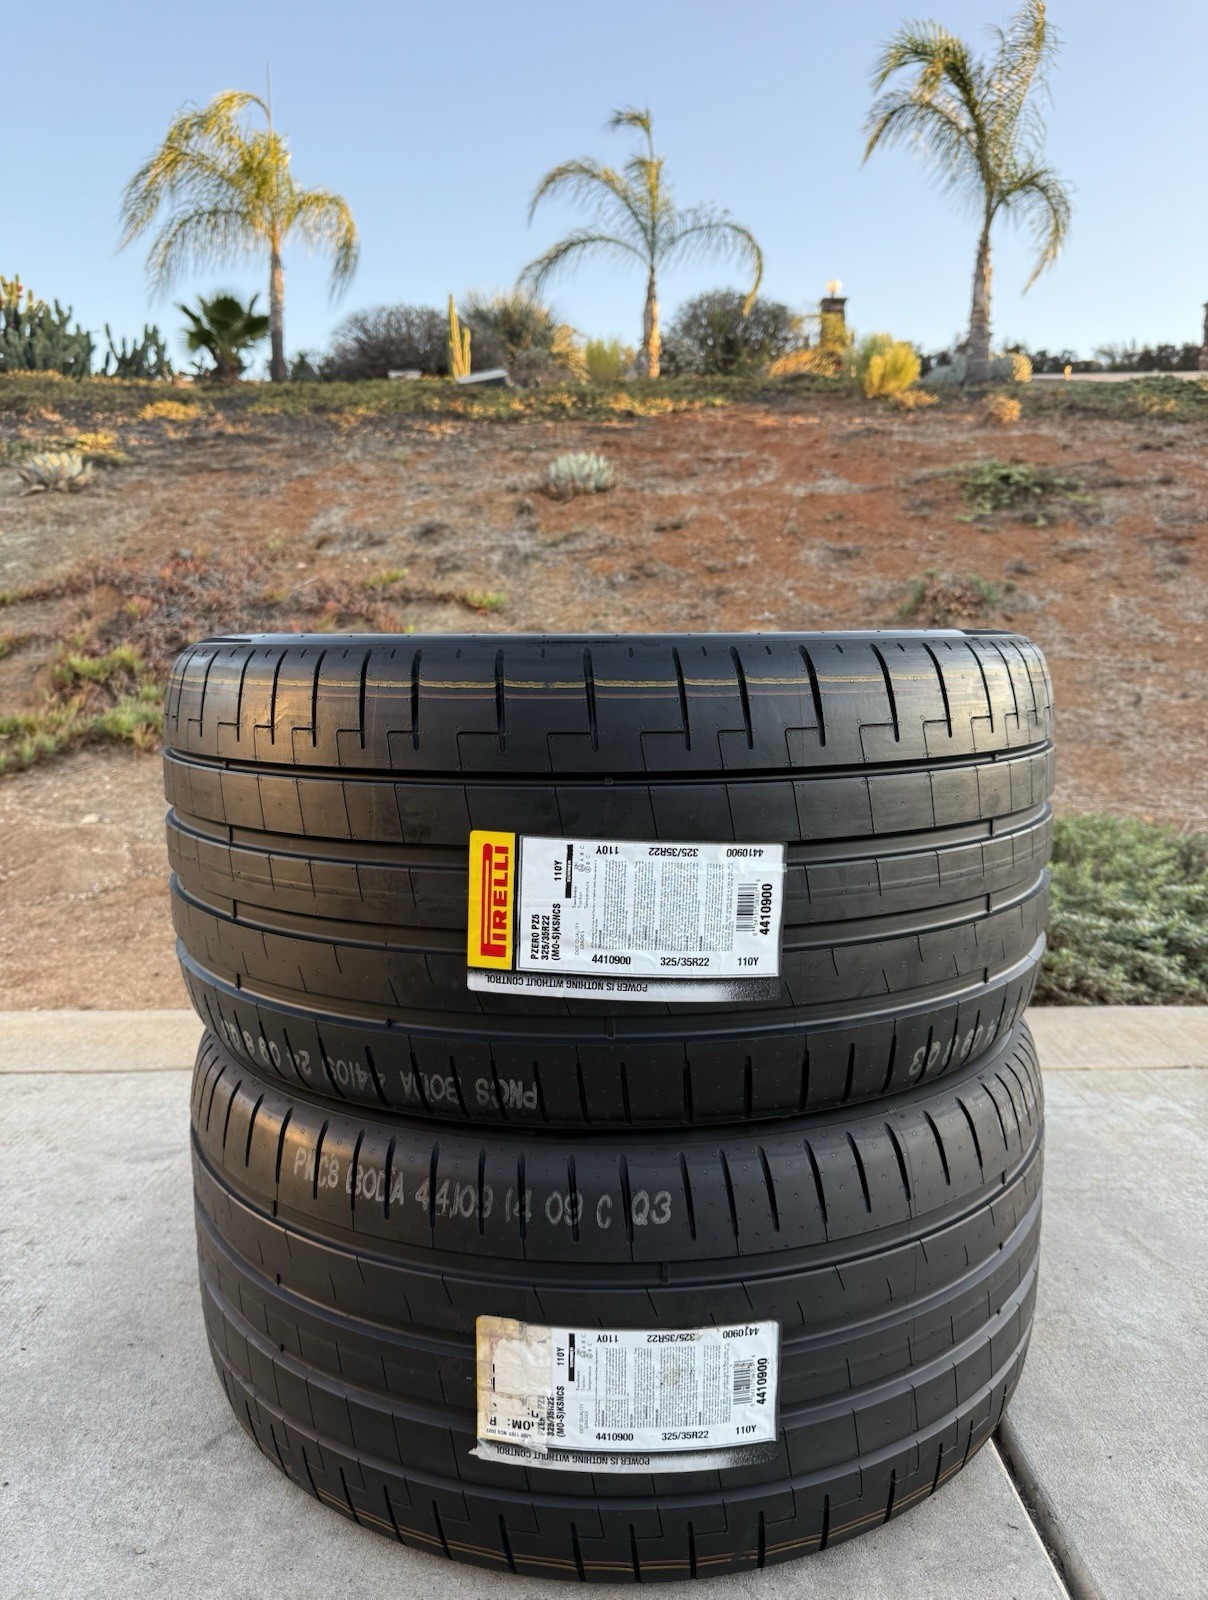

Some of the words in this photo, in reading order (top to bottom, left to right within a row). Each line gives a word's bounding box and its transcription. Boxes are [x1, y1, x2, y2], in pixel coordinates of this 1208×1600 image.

[596, 846, 619, 855] 110Y
[648, 848, 698, 857] 325/35R22
[726, 848, 764, 858] 4410900
[554, 860, 563, 882] 110Y
[480, 843, 510, 958] PIRELLI
[759, 883, 773, 936] 4410900
[532, 914, 540, 930] PZ5
[541, 915, 550, 960] 325/35R22
[551, 903, 562, 961] (MO-S)KSNCS
[530, 931, 540, 960] PZERO
[592, 954, 632, 966] 4410900
[660, 956, 710, 966] 325/35R22
[738, 956, 759, 966] 110Y
[484, 974, 524, 986] CONTROL
[526, 976, 564, 988] WITHOUT
[566, 978, 604, 990] NOTHING
[606, 981, 616, 991] IS
[617, 981, 648, 992] POWER
[722, 1326, 760, 1338] 4410900
[596, 1334, 618, 1343] 110Y
[646, 1334, 696, 1343] 325/35R22
[557, 1346, 565, 1366] 110Y
[756, 1358, 768, 1405] 4410900
[556, 1385, 566, 1438] (MO-S)KSNCS
[662, 1430, 709, 1441] 325/35R22
[736, 1424, 757, 1435] 110Y
[596, 1432, 634, 1442] 4410900
[496, 1445, 532, 1458] CONTROL
[532, 1450, 570, 1462] WITHOUT
[572, 1453, 610, 1465] NOTHING
[610, 1456, 620, 1466] IS
[620, 1457, 650, 1466] POWER
